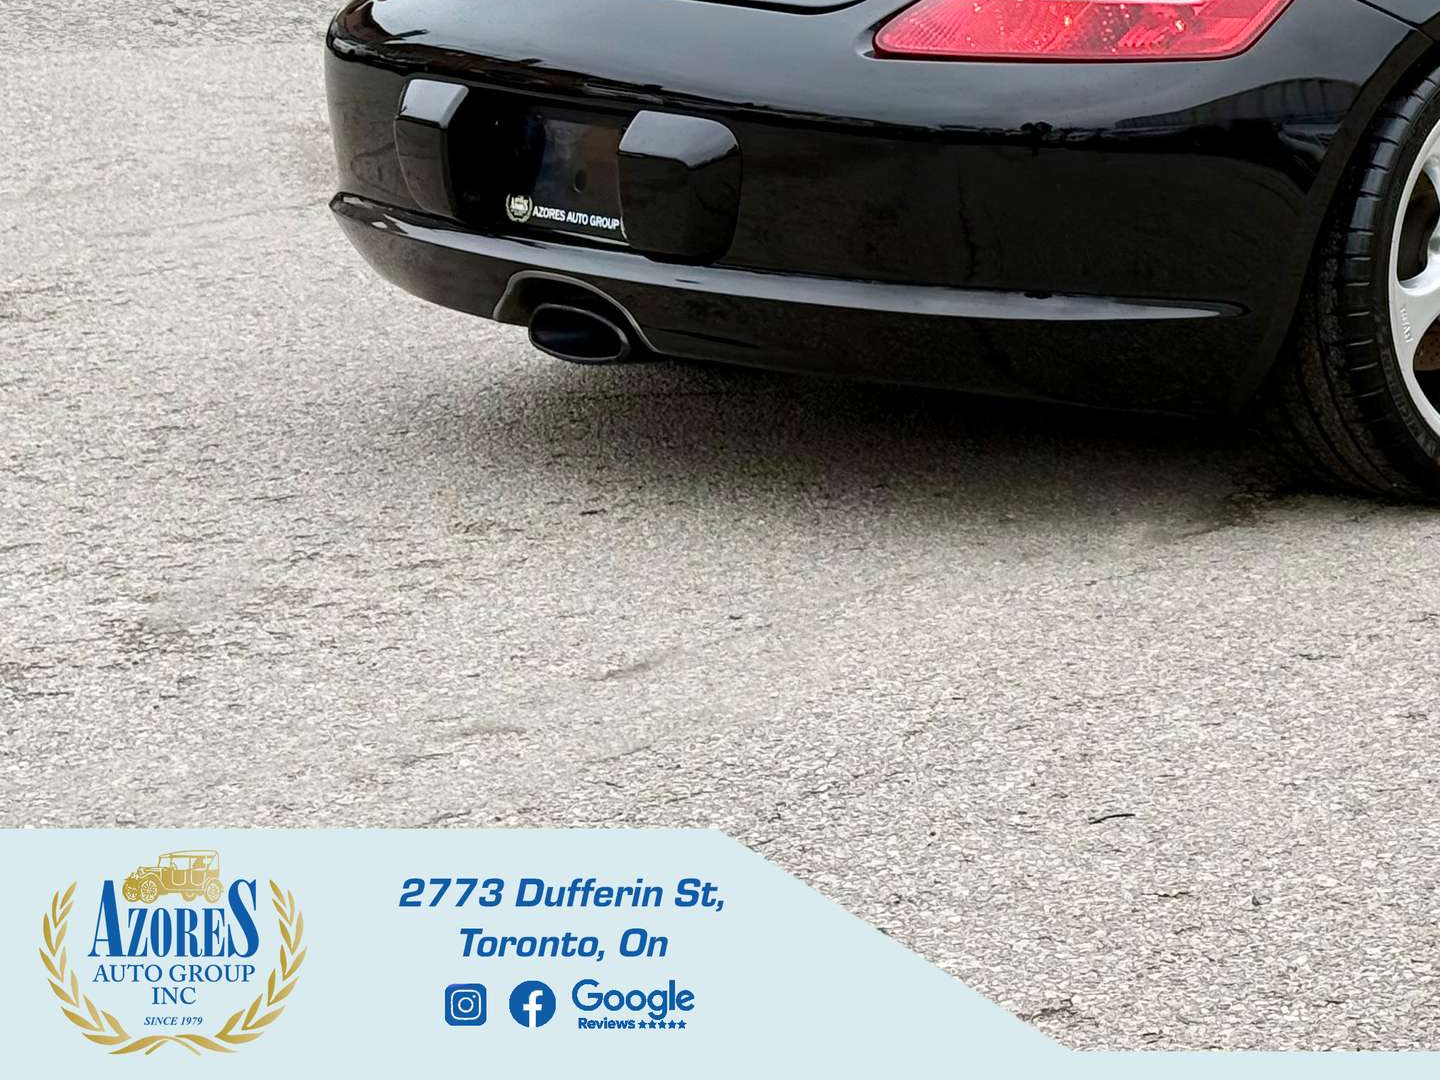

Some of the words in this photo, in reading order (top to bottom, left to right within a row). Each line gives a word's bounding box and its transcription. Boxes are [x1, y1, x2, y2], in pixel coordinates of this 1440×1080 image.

[532, 206, 566, 221] AZORES
[566, 211, 589, 226] AUTO
[589, 215, 620, 230] GROUP
